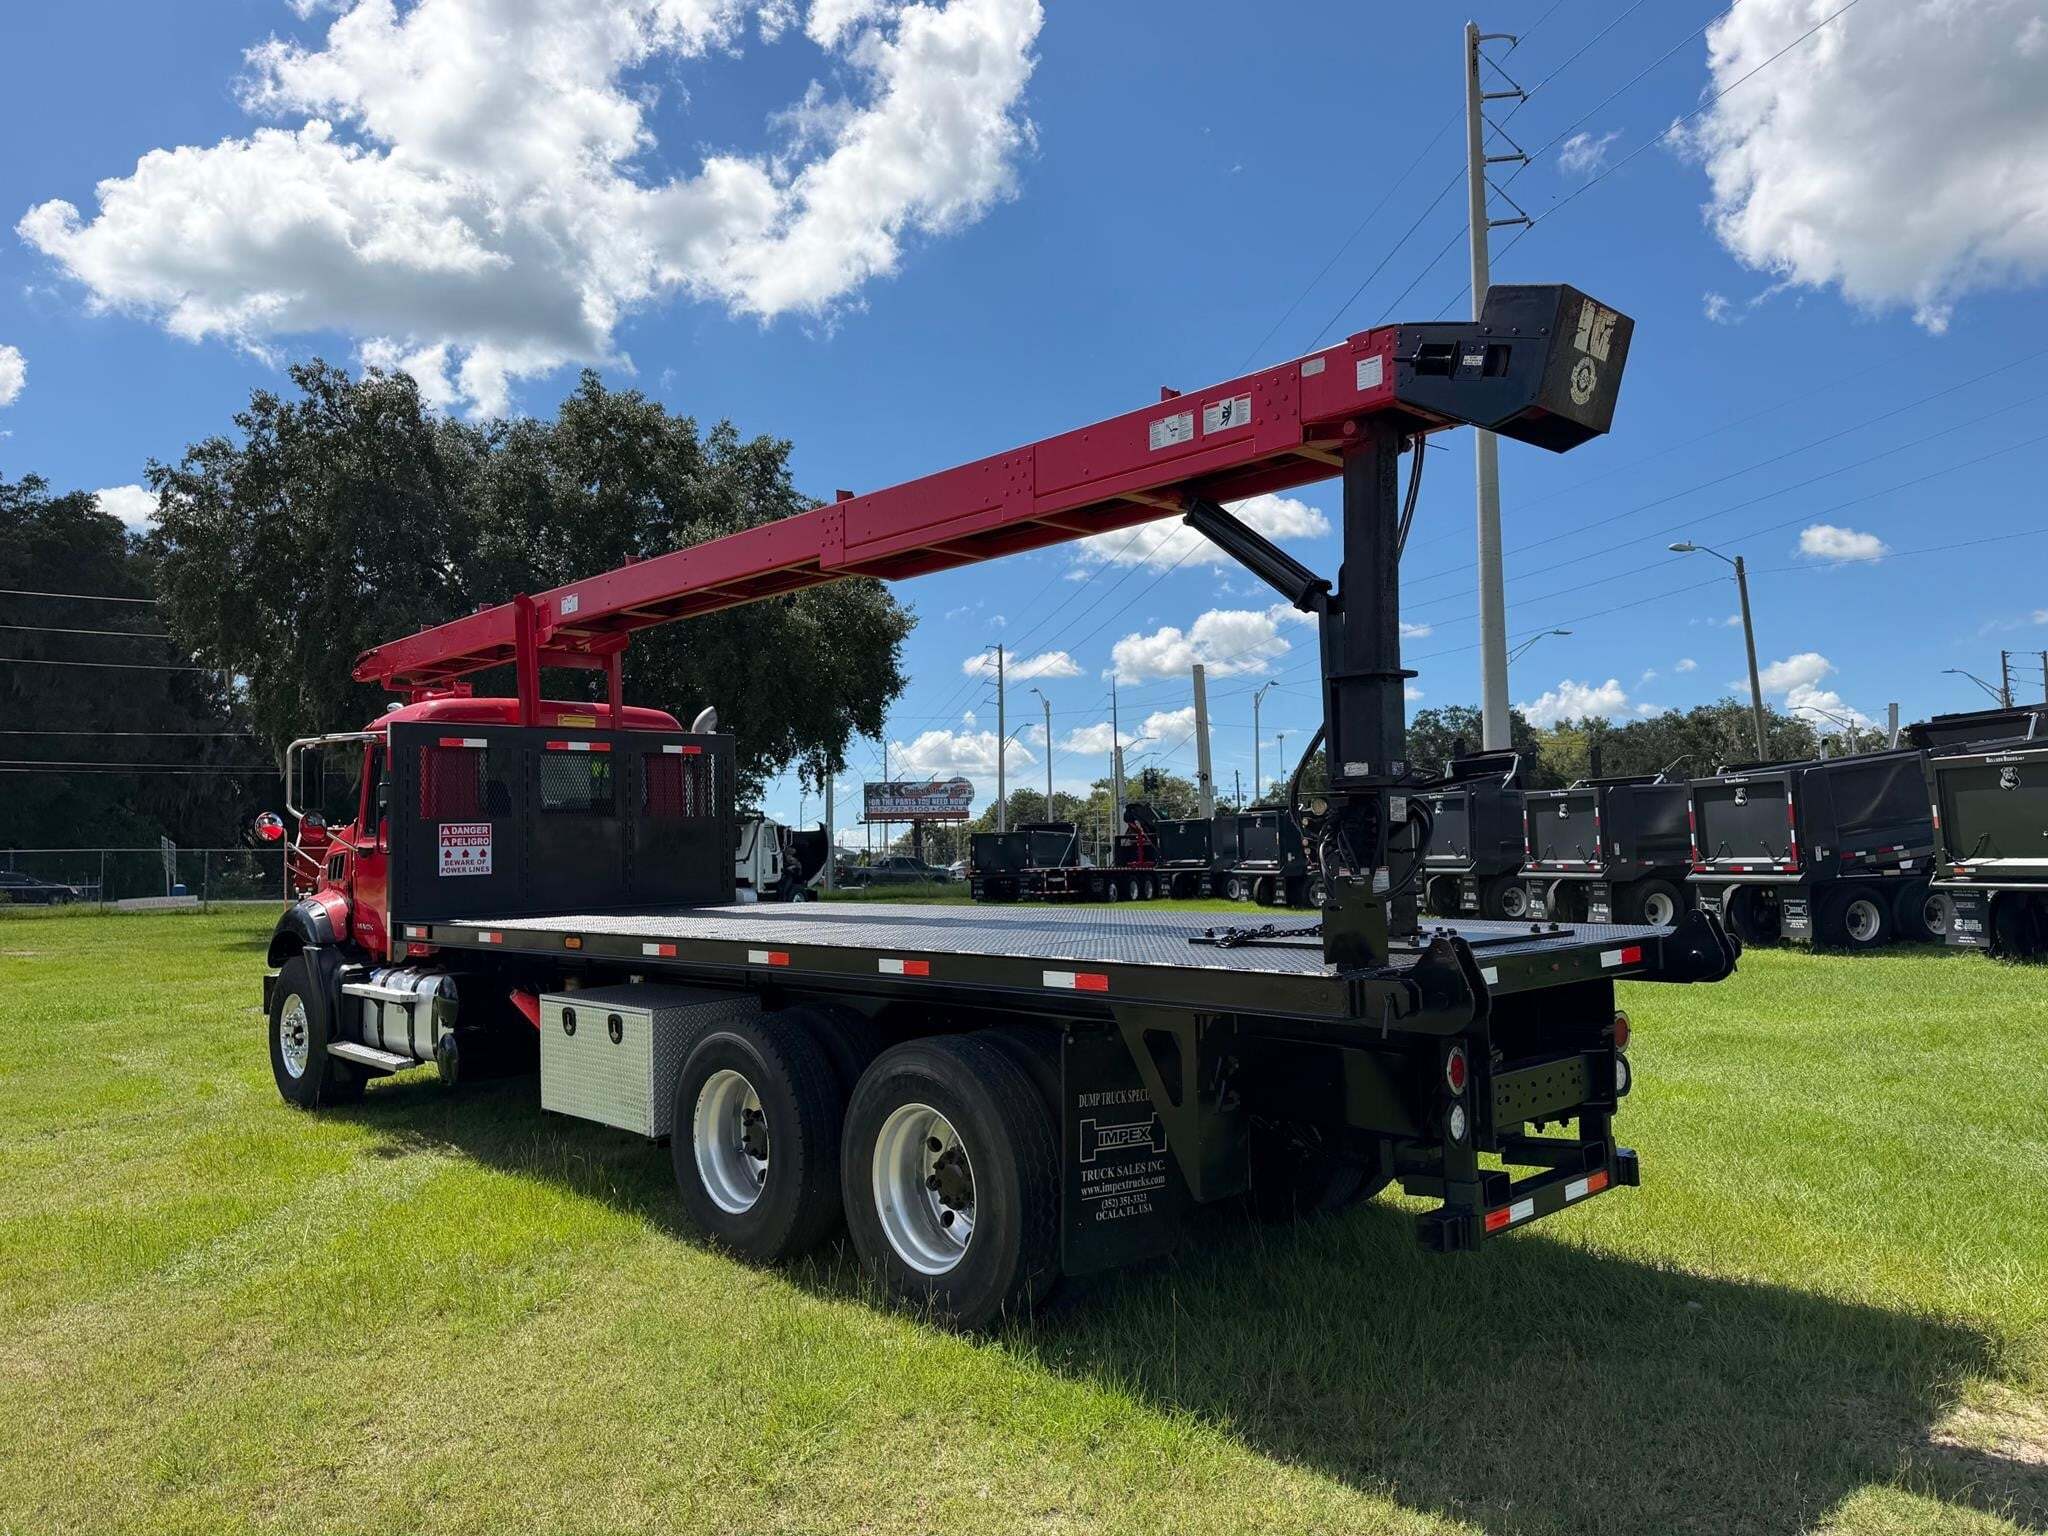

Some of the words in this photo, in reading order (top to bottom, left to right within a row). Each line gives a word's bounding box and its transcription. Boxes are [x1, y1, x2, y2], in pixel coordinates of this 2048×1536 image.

[451, 826, 488, 835] DANGER
[452, 838, 489, 846] PELIGRO
[441, 866, 467, 874] POWER
[1079, 1093, 1100, 1108] DUMP
[1101, 1090, 1127, 1105] TRUCK
[1098, 1126, 1152, 1146] IMPEX
[1081, 1167, 1115, 1182] TRUCK
[1117, 1162, 1146, 1177] SALES
[1081, 1176, 1165, 1196] www.impextrucks.com
[1139, 1203, 1153, 1214] USA
